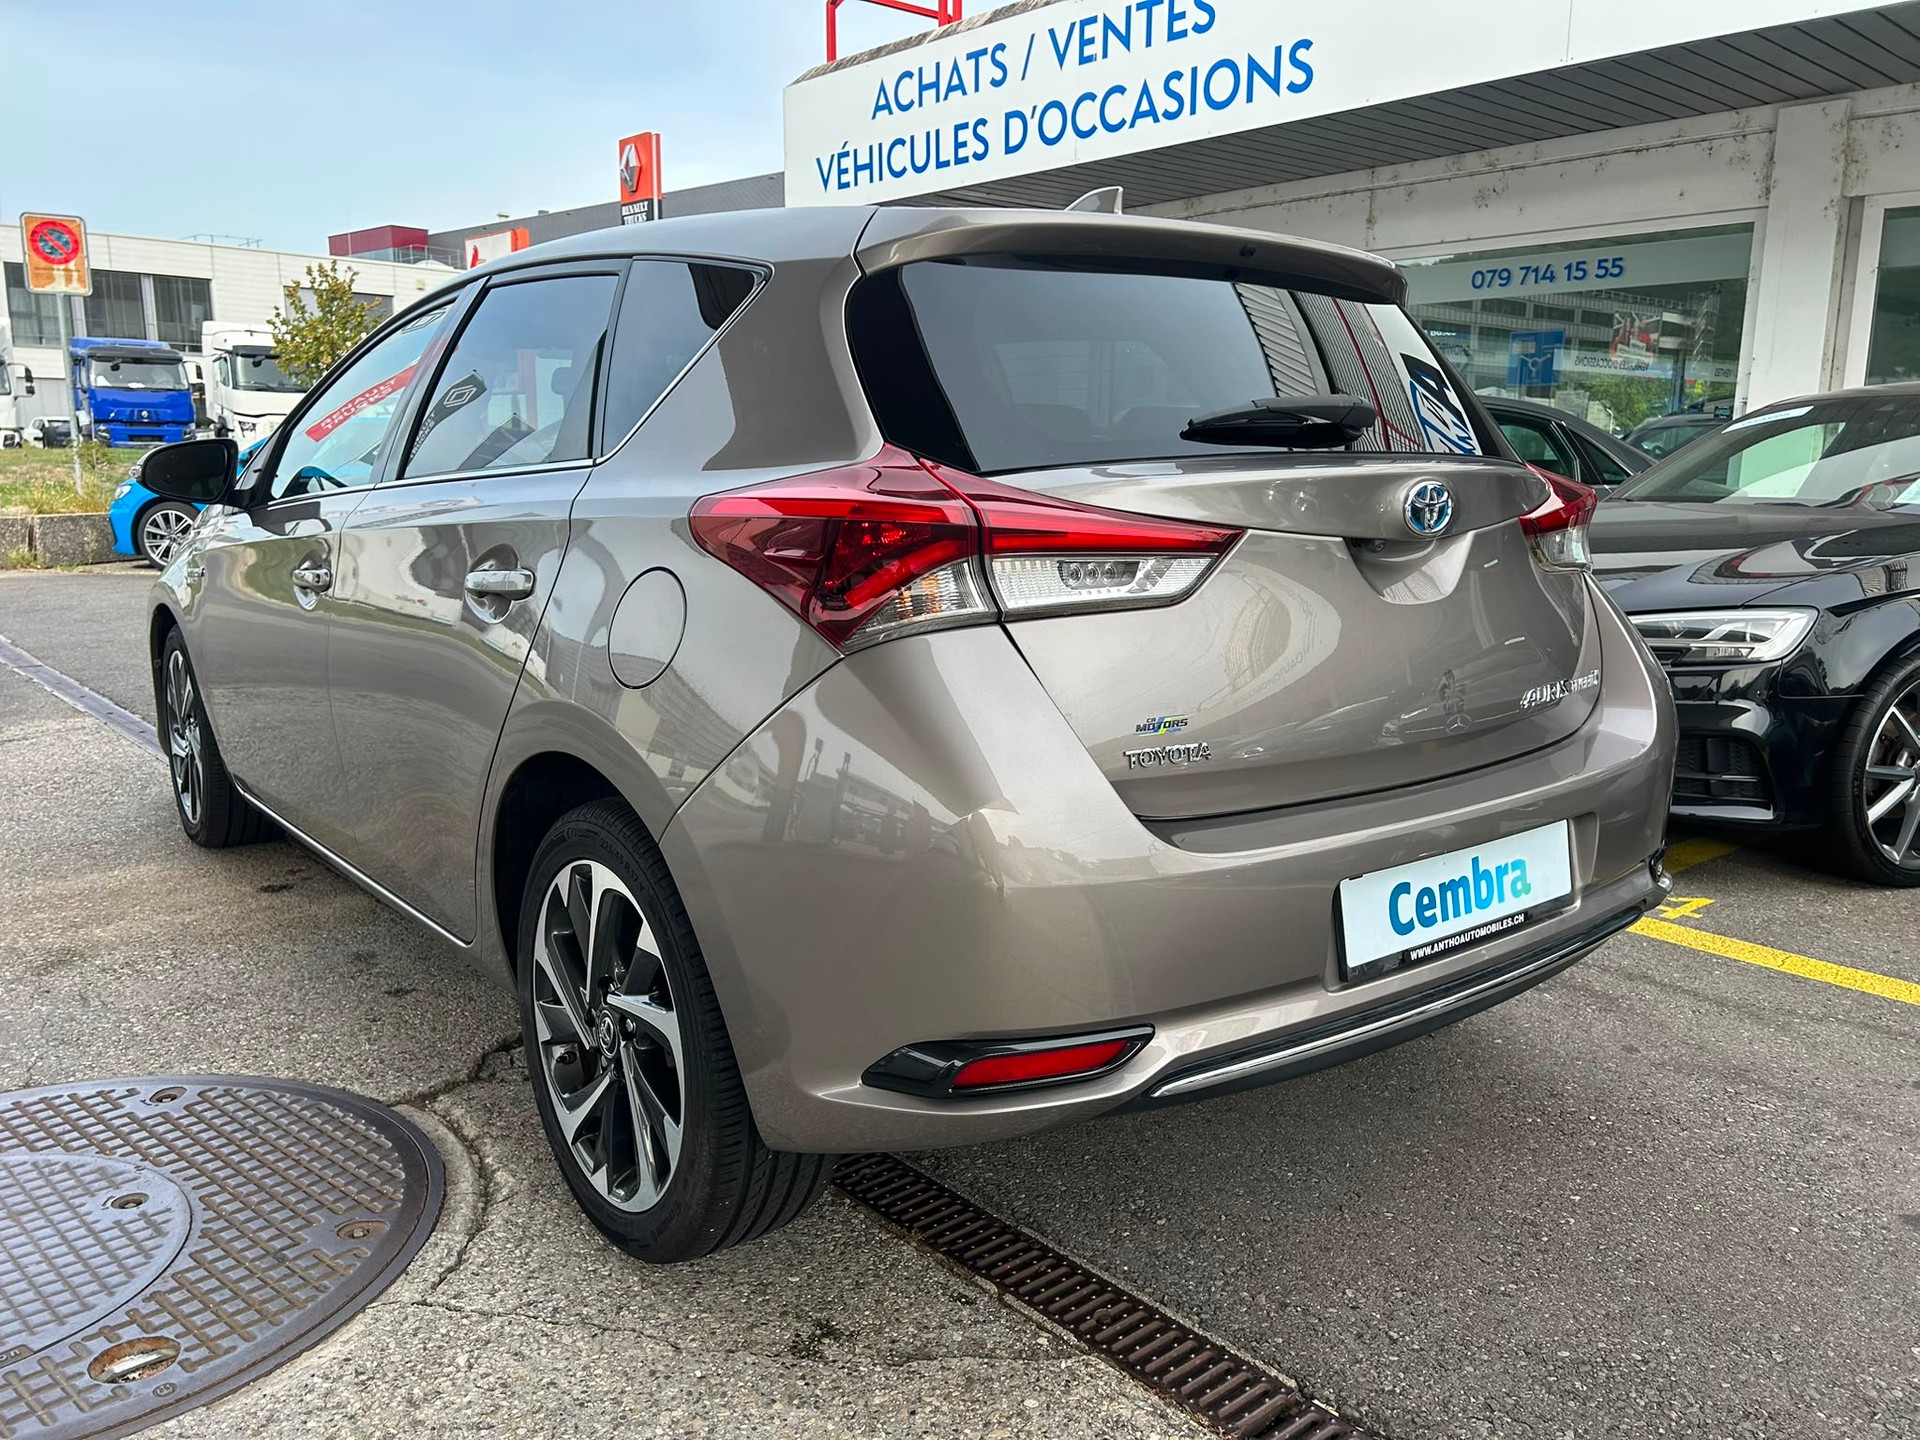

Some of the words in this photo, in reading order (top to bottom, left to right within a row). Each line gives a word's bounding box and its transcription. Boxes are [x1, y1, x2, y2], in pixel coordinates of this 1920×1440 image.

[871, 43, 1008, 120] ACHATS
[1021, 33, 1036, 81] /
[1047, 0, 1216, 70] VENTES
[815, 117, 989, 192] VÉHICULES
[1004, 39, 1315, 155] D'OCCASIONS
[622, 201, 648, 215] RENAULT
[1470, 267, 1512, 290] 079
[1519, 263, 1556, 285] 714
[1563, 260, 1587, 281] 15
[1594, 257, 1625, 279] 55
[320, 378, 397, 430] RENAULT
[323, 387, 393, 430] TRUCKS
[1136, 718, 1188, 731] MOTORS
[1124, 742, 1212, 770] TOYOTA
[1388, 856, 1532, 937] Cembra
[1410, 913, 1525, 961] WWW.ANTHOAUTOMOBILES.CH
